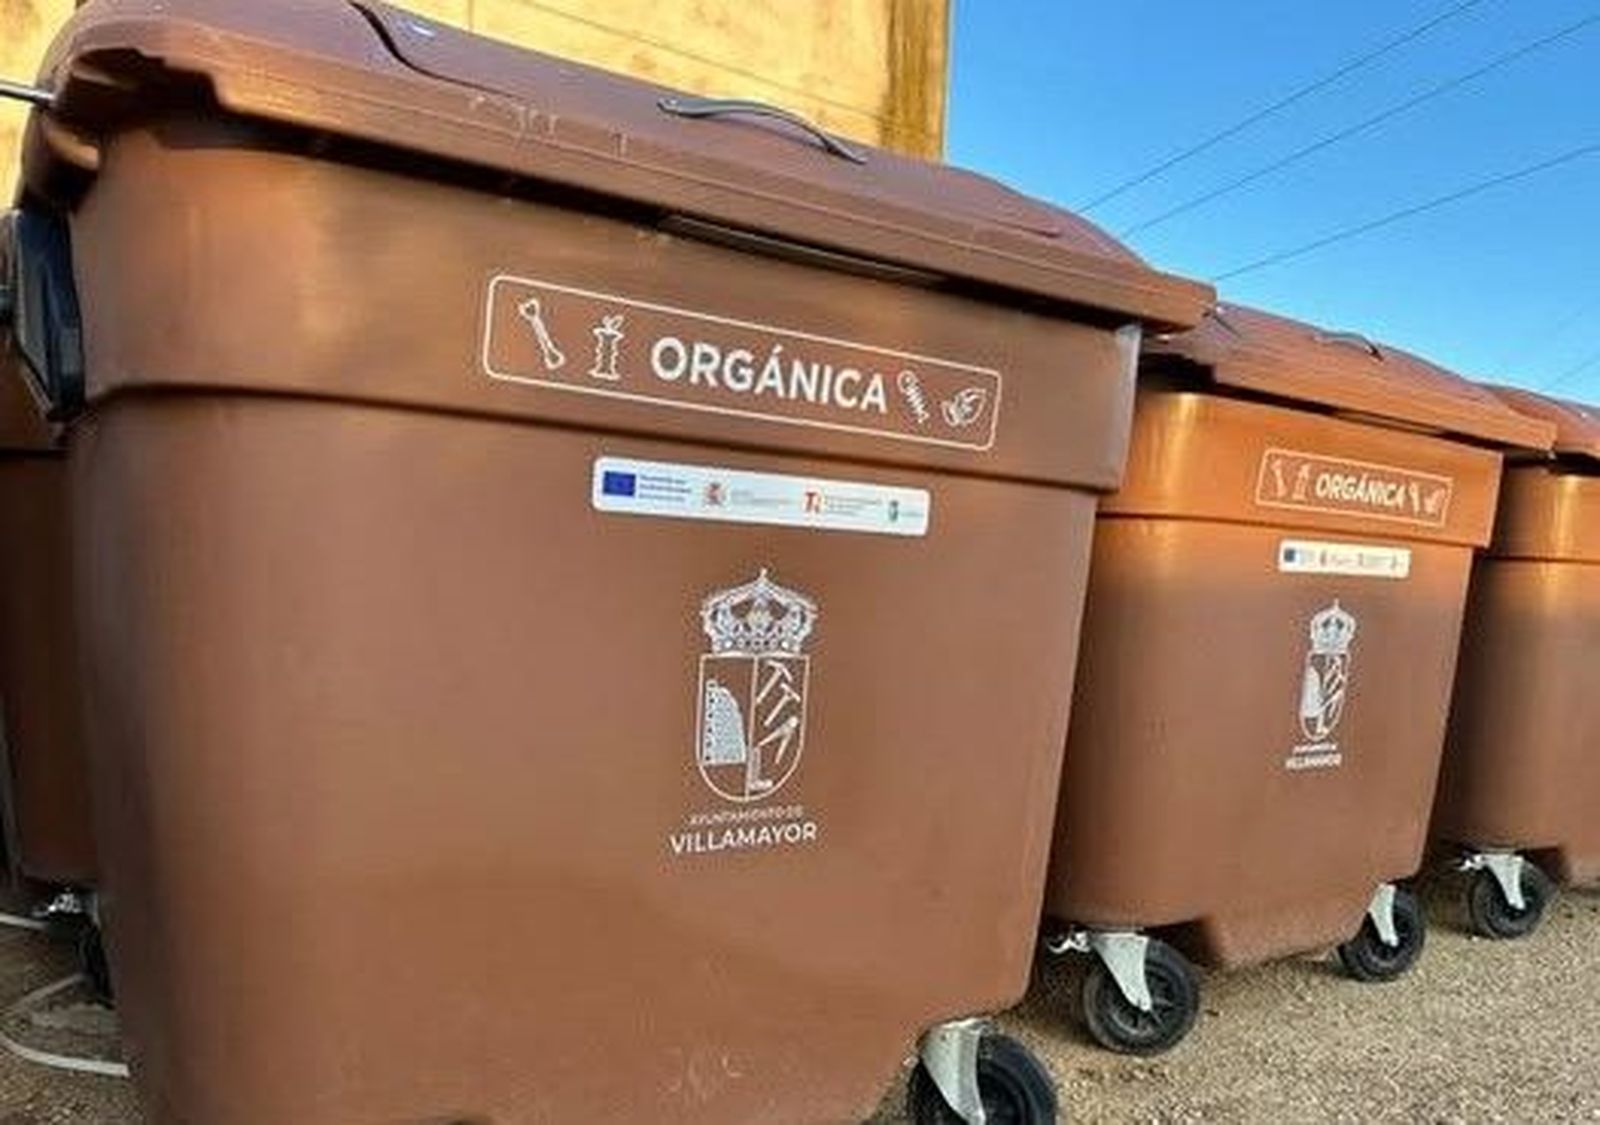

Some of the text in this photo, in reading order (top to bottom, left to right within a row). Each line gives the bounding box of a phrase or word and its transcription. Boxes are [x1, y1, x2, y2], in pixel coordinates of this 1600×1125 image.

[651, 337, 888, 413] ORGÁNICA
[1315, 474, 1405, 509] ORGÁNICA
[670, 822, 817, 853] VILLAMAYOR
